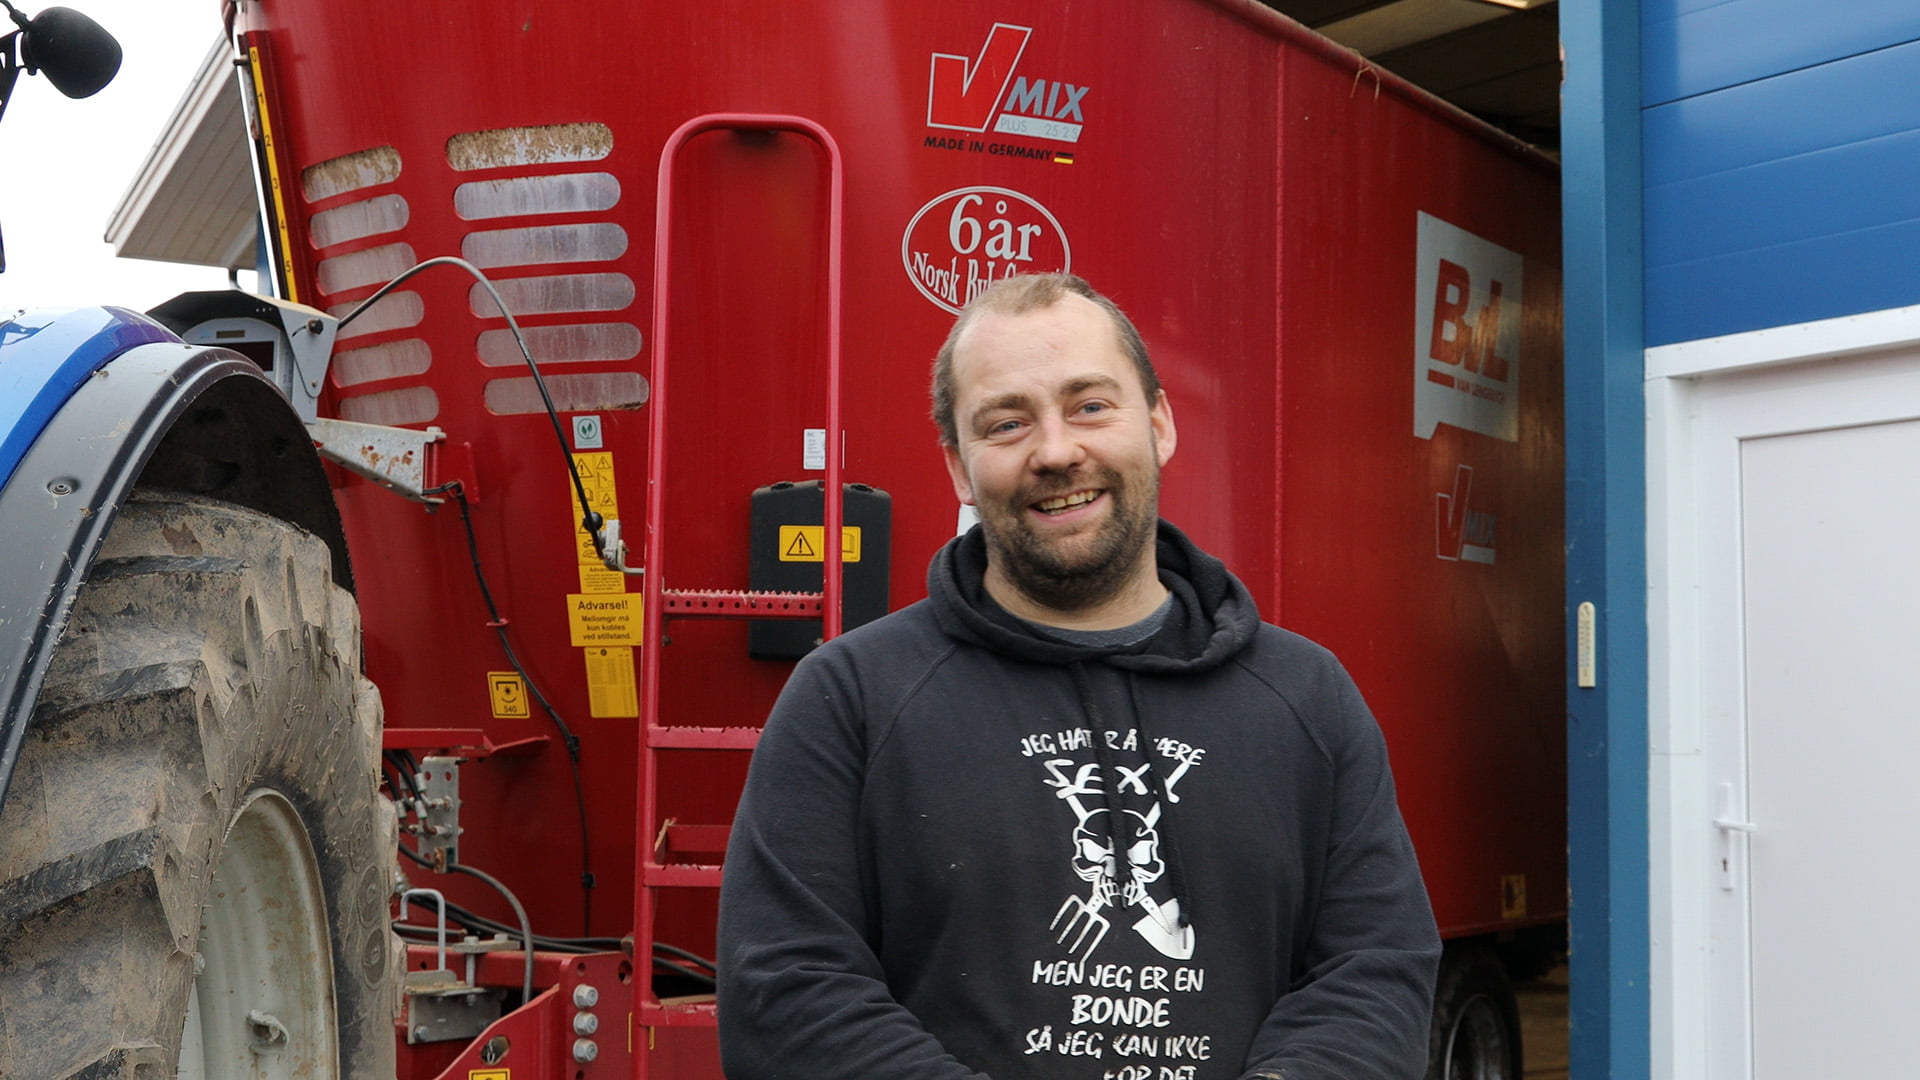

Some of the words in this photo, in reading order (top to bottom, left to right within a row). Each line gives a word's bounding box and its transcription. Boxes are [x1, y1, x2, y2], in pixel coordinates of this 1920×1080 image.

[1003, 76, 1090, 122] MIX
[1001, 117, 1027, 133] PLUS
[924, 136, 965, 151] MADE
[969, 141, 985, 152] IN
[989, 143, 1053, 160] GERMANY
[913, 251, 960, 305] Norsk
[578, 600, 628, 610] Advarsel!
[1020, 733, 1057, 757] JEG
[1122, 728, 1137, 751] Å
[1032, 960, 1086, 986] MEN
[1089, 964, 1133, 992] JEG
[1140, 966, 1170, 992] ER
[1174, 967, 1204, 992] EN
[1071, 994, 1170, 1028] BONDE
[1023, 1025, 1052, 1055] SÅ
[1058, 1031, 1104, 1059] JEG
[1112, 1034, 1159, 1057] KAN
[1165, 1035, 1211, 1060] IKKE
